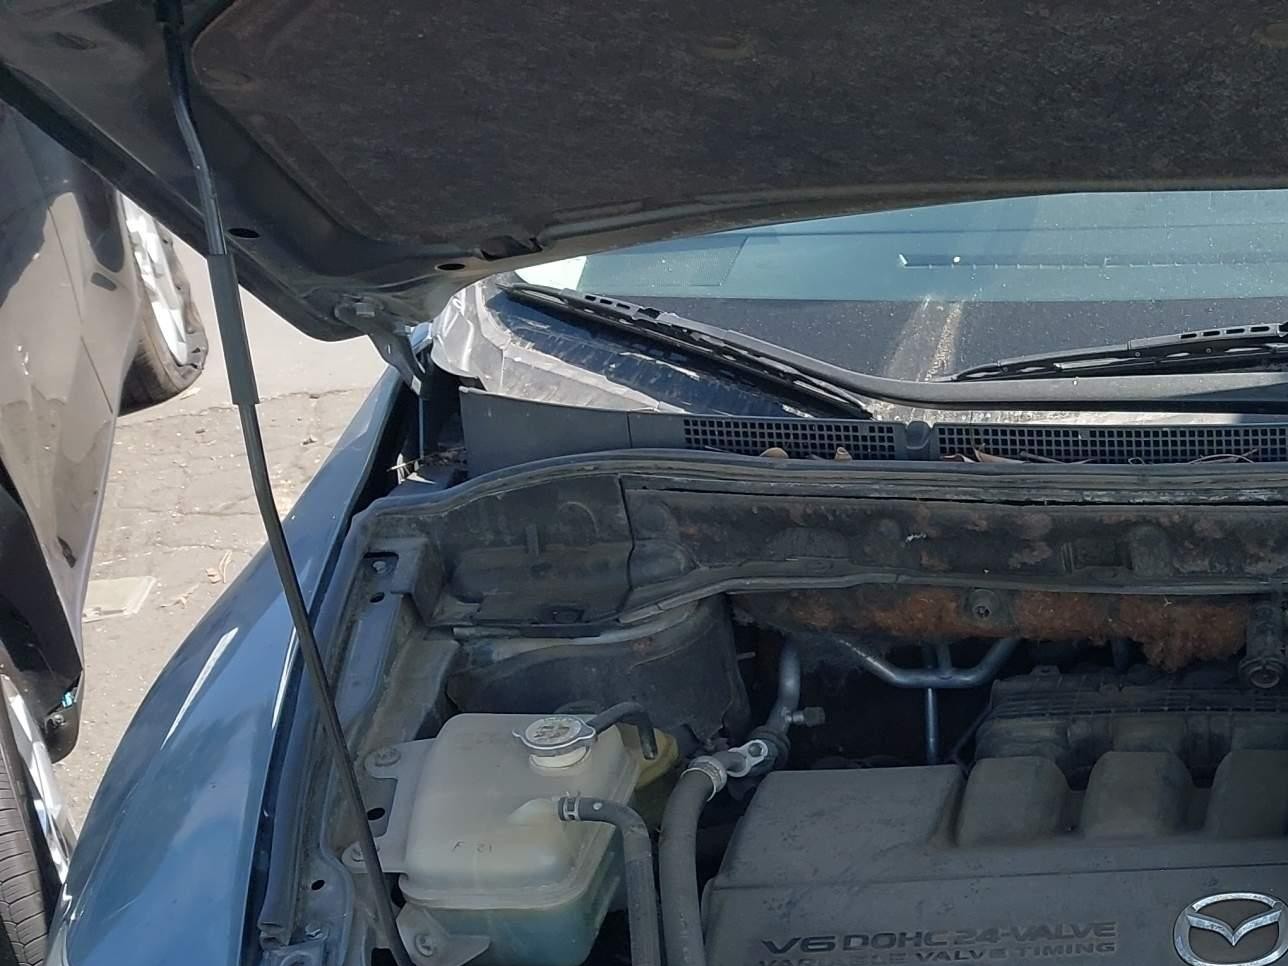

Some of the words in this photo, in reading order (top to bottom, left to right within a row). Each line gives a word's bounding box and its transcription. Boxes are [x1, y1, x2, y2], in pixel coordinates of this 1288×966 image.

[761, 935, 836, 954] V6
[843, 930, 948, 951] DOHC
[953, 921, 1117, 945] 24-VALVE
[915, 947, 1008, 961] VALVE
[1018, 942, 1117, 957] TIMING
